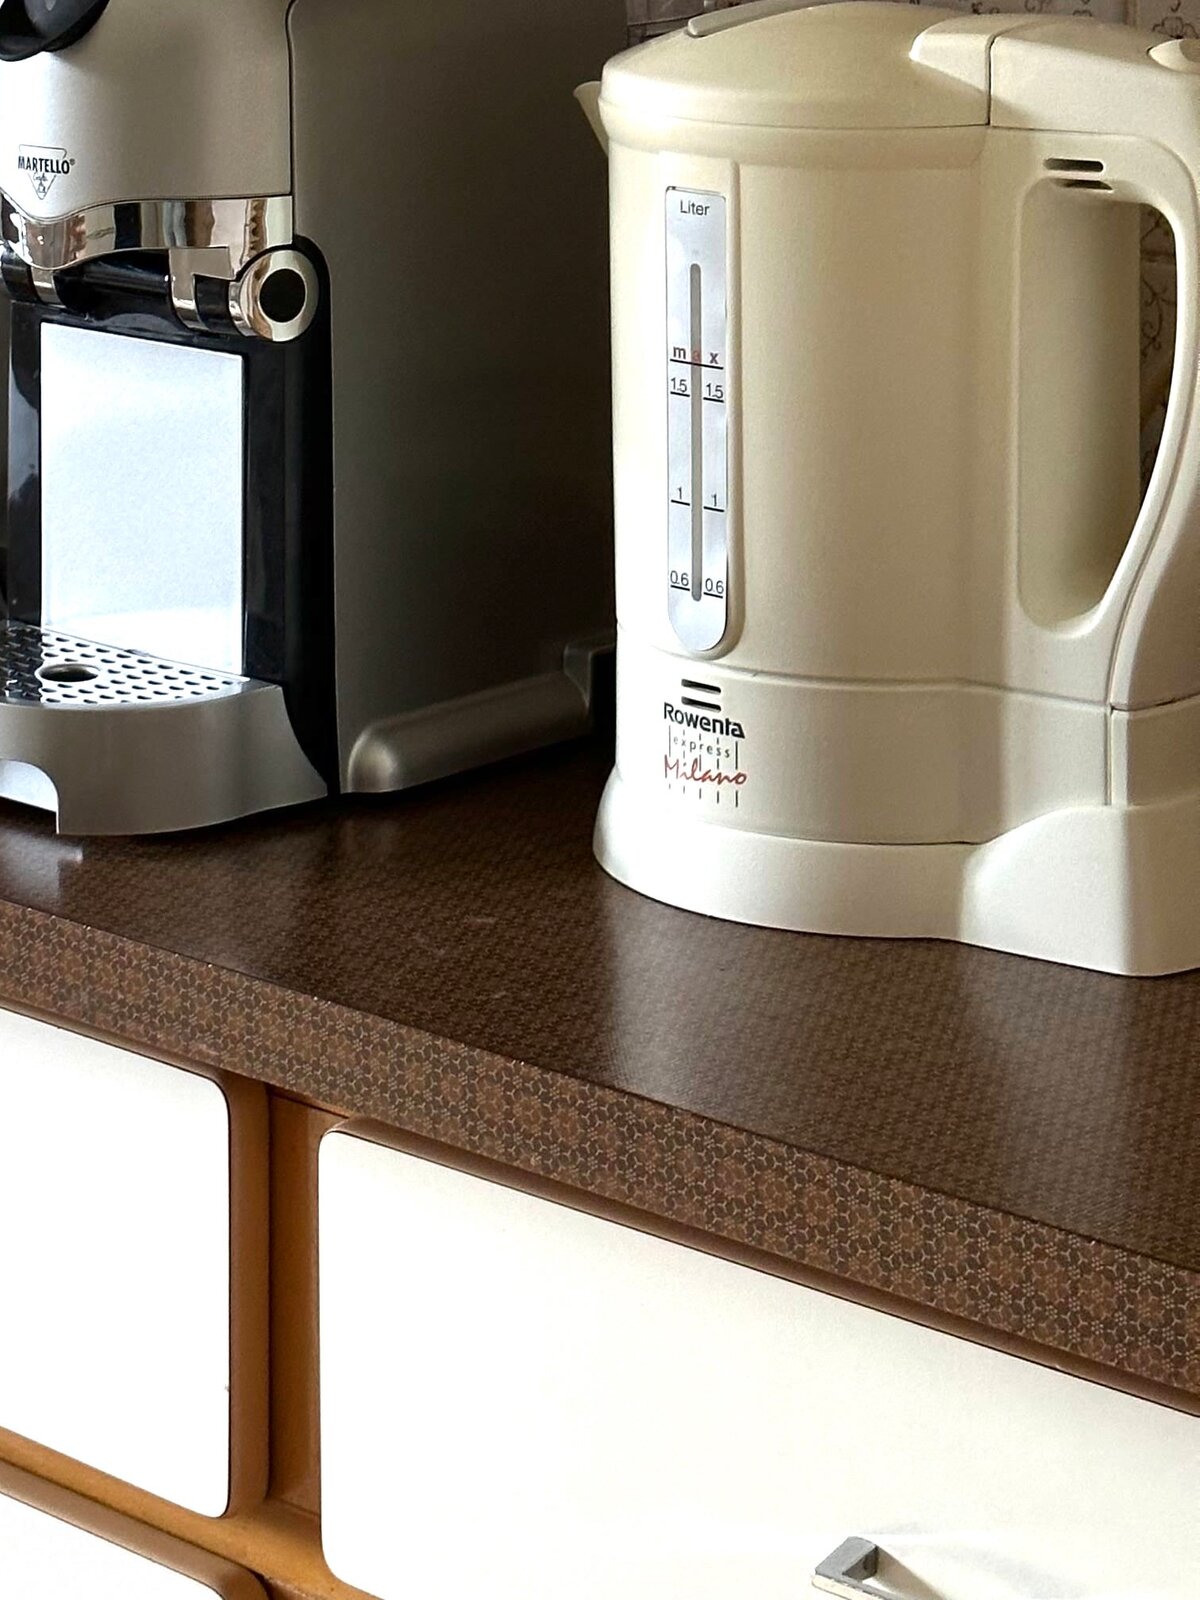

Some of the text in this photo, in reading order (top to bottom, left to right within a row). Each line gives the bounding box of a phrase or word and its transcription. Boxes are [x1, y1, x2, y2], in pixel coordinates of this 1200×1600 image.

[18, 155, 70, 174] MARTELLO
[680, 199, 710, 216] Liter
[677, 487, 682, 500] 1
[712, 494, 718, 507] 1
[670, 570, 689, 587] 0.6
[705, 578, 724, 595] 0.6
[664, 702, 745, 739] Rowenta
[673, 736, 730, 758] express
[664, 754, 747, 785] Milano
